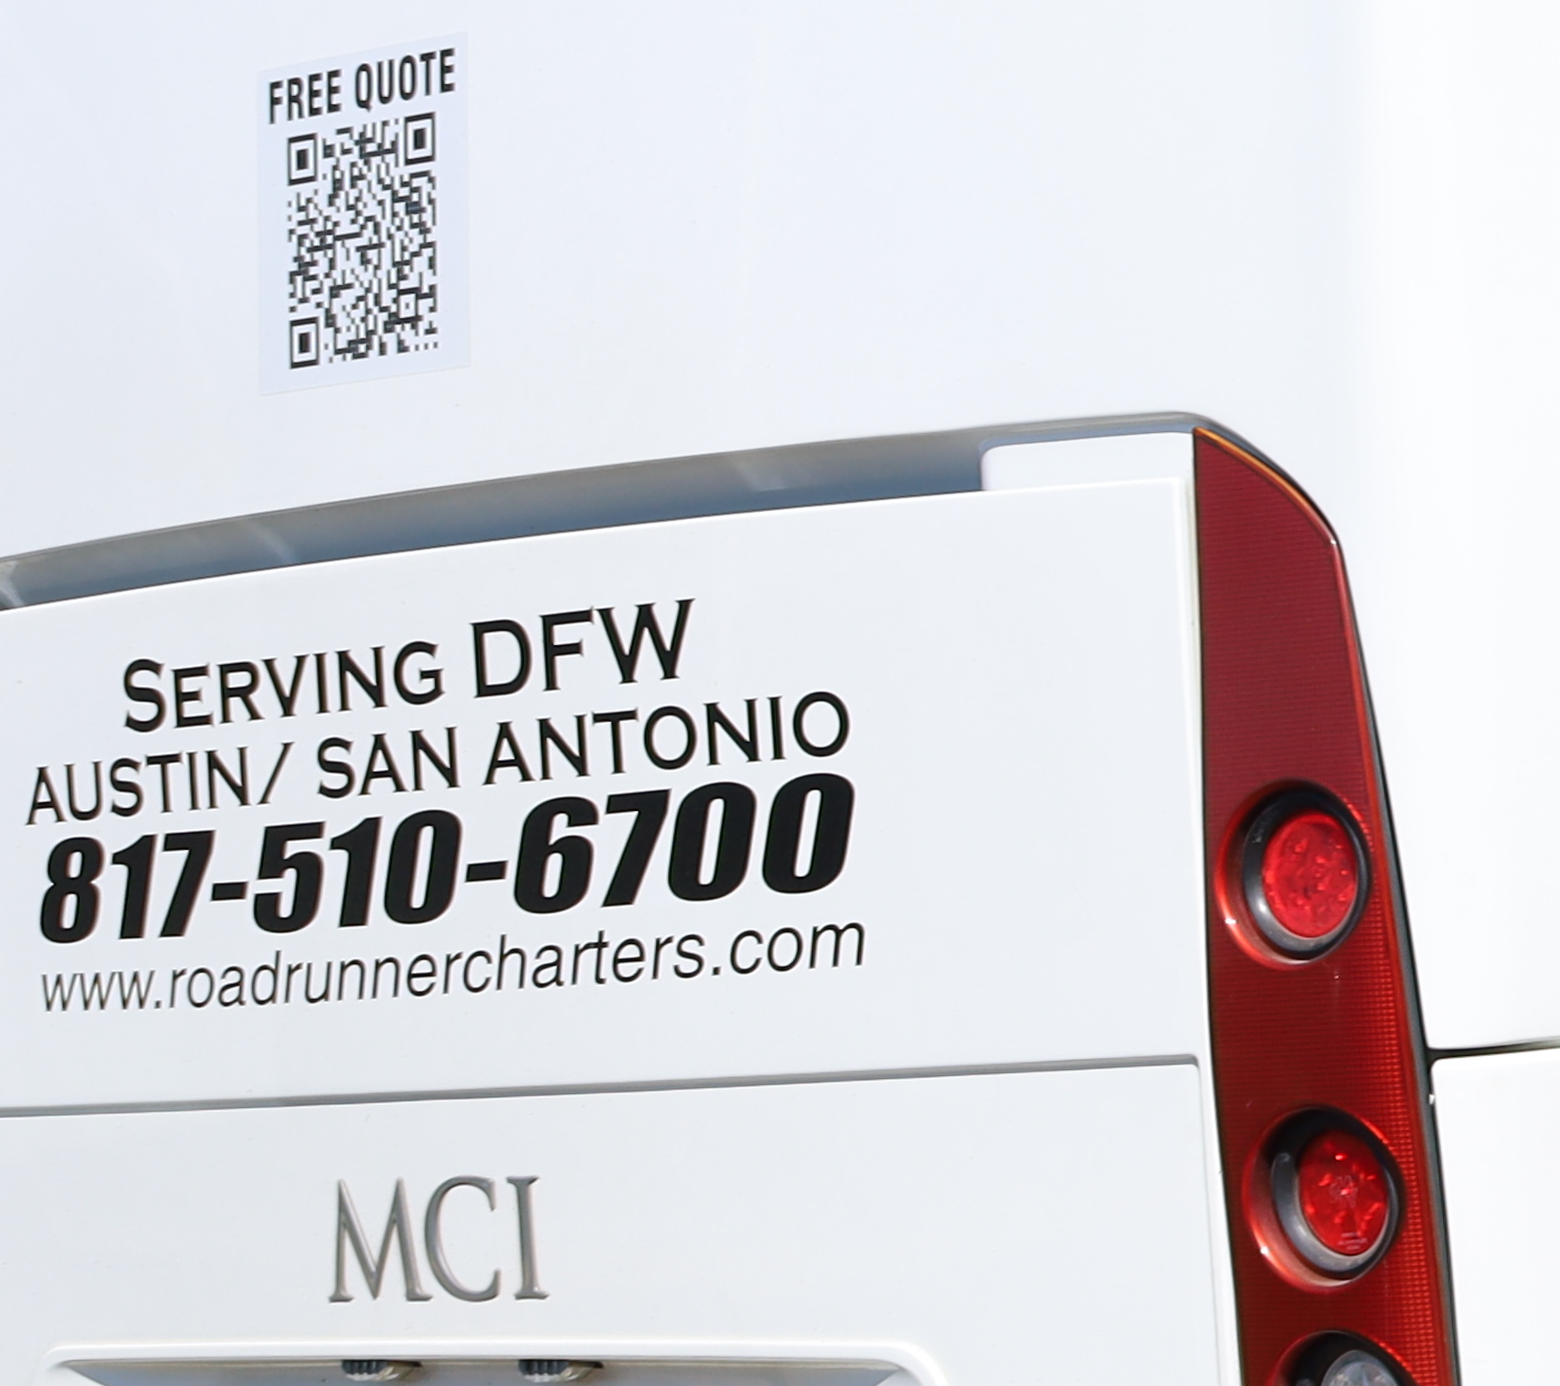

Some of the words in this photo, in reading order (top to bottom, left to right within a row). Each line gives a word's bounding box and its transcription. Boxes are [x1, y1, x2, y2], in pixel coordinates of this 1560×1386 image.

[268, 68, 342, 125] FREE
[355, 47, 456, 112] QUOTE
[123, 640, 445, 734] SERVING
[471, 597, 696, 698] DFW
[25, 741, 294, 826] AUSTIN/
[316, 725, 460, 800] SAN
[484, 690, 851, 785] ANTONIO
[39, 771, 857, 943] 817-510-6700
[40, 919, 866, 1012] www.roadrunnercharters.com
[328, 1175, 549, 1303] MCI
